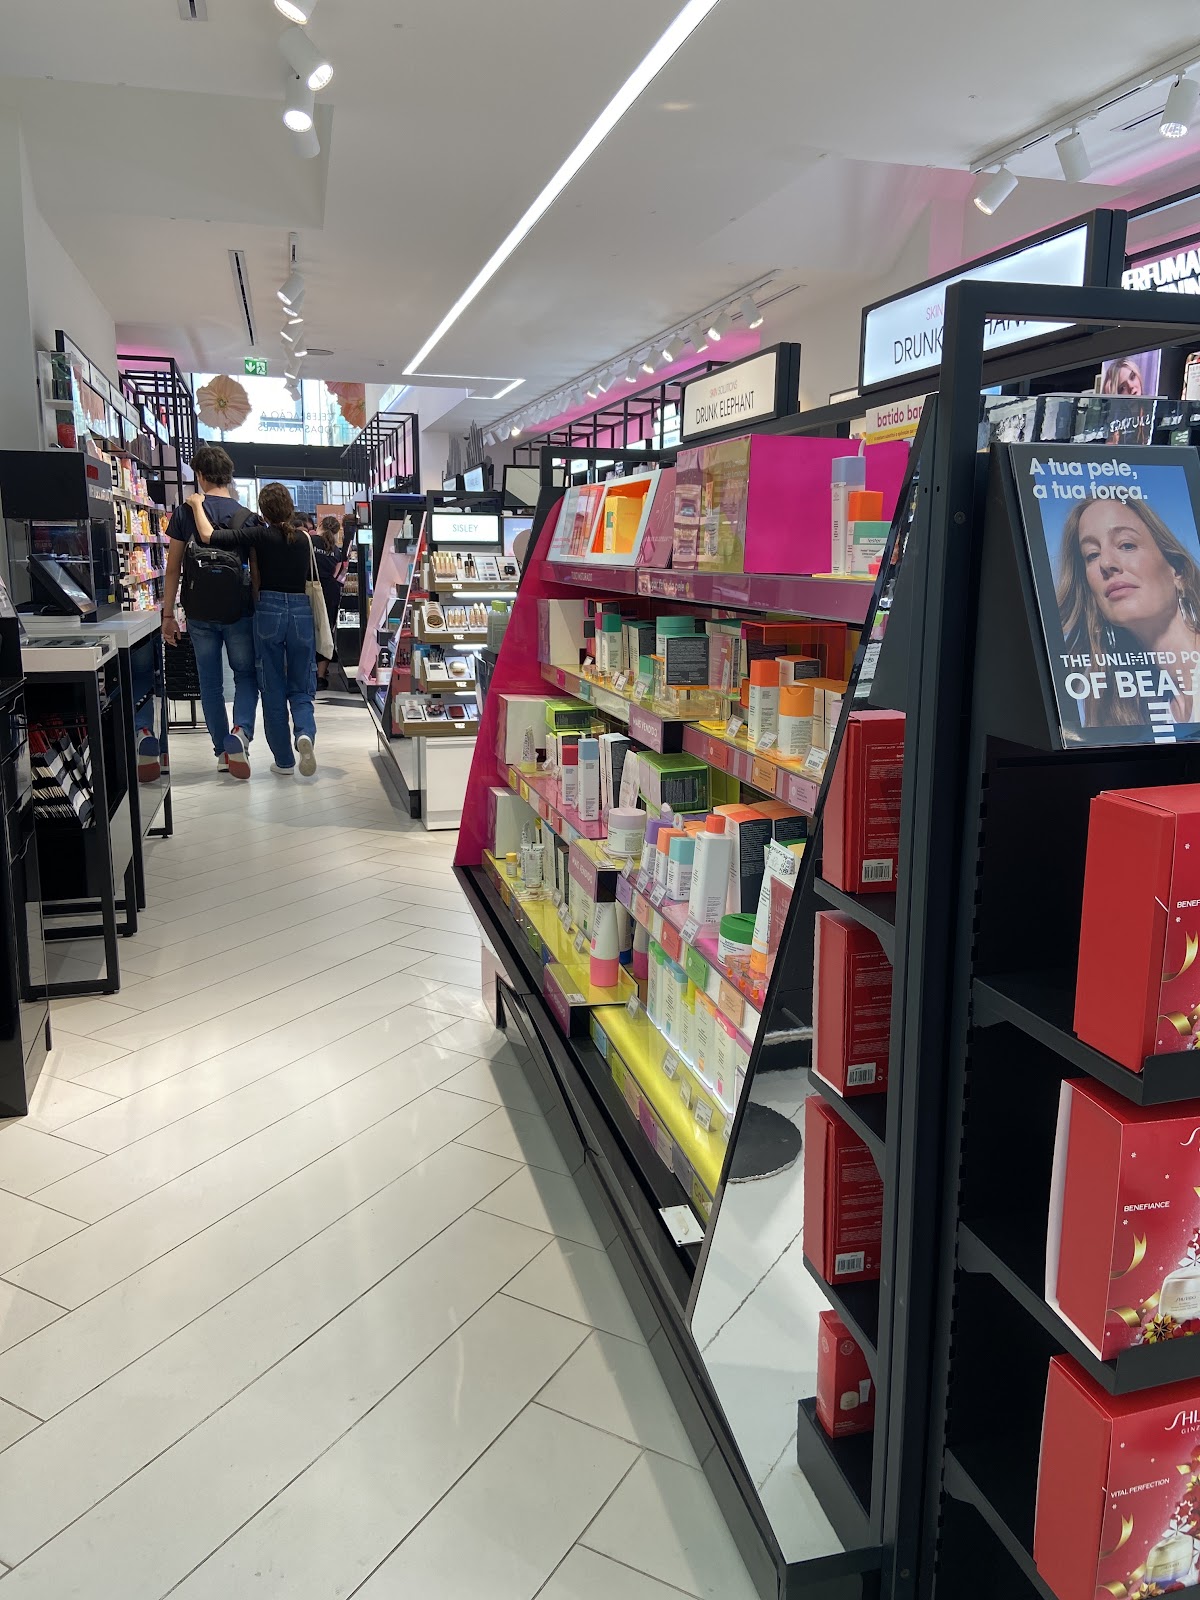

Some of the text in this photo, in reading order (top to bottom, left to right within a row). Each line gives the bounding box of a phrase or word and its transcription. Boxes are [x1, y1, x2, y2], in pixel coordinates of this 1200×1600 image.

[894, 326, 944, 364] DRUNK
[696, 391, 754, 425] DRUNK ELEPHANT
[877, 404, 923, 428] batido bar
[1029, 457, 1138, 480] A tua pele,
[1032, 480, 1148, 505] a tua força.
[452, 524, 479, 533] SISLEY
[1060, 654, 1092, 668] THE
[1095, 651, 1177, 667] UNLIMITED
[1064, 671, 1108, 700] OF
[1123, 1200, 1170, 1213] BENEFIANCE
[1164, 1409, 1200, 1431] SHI
[1110, 1477, 1170, 1499] VITAL PERFECTION
